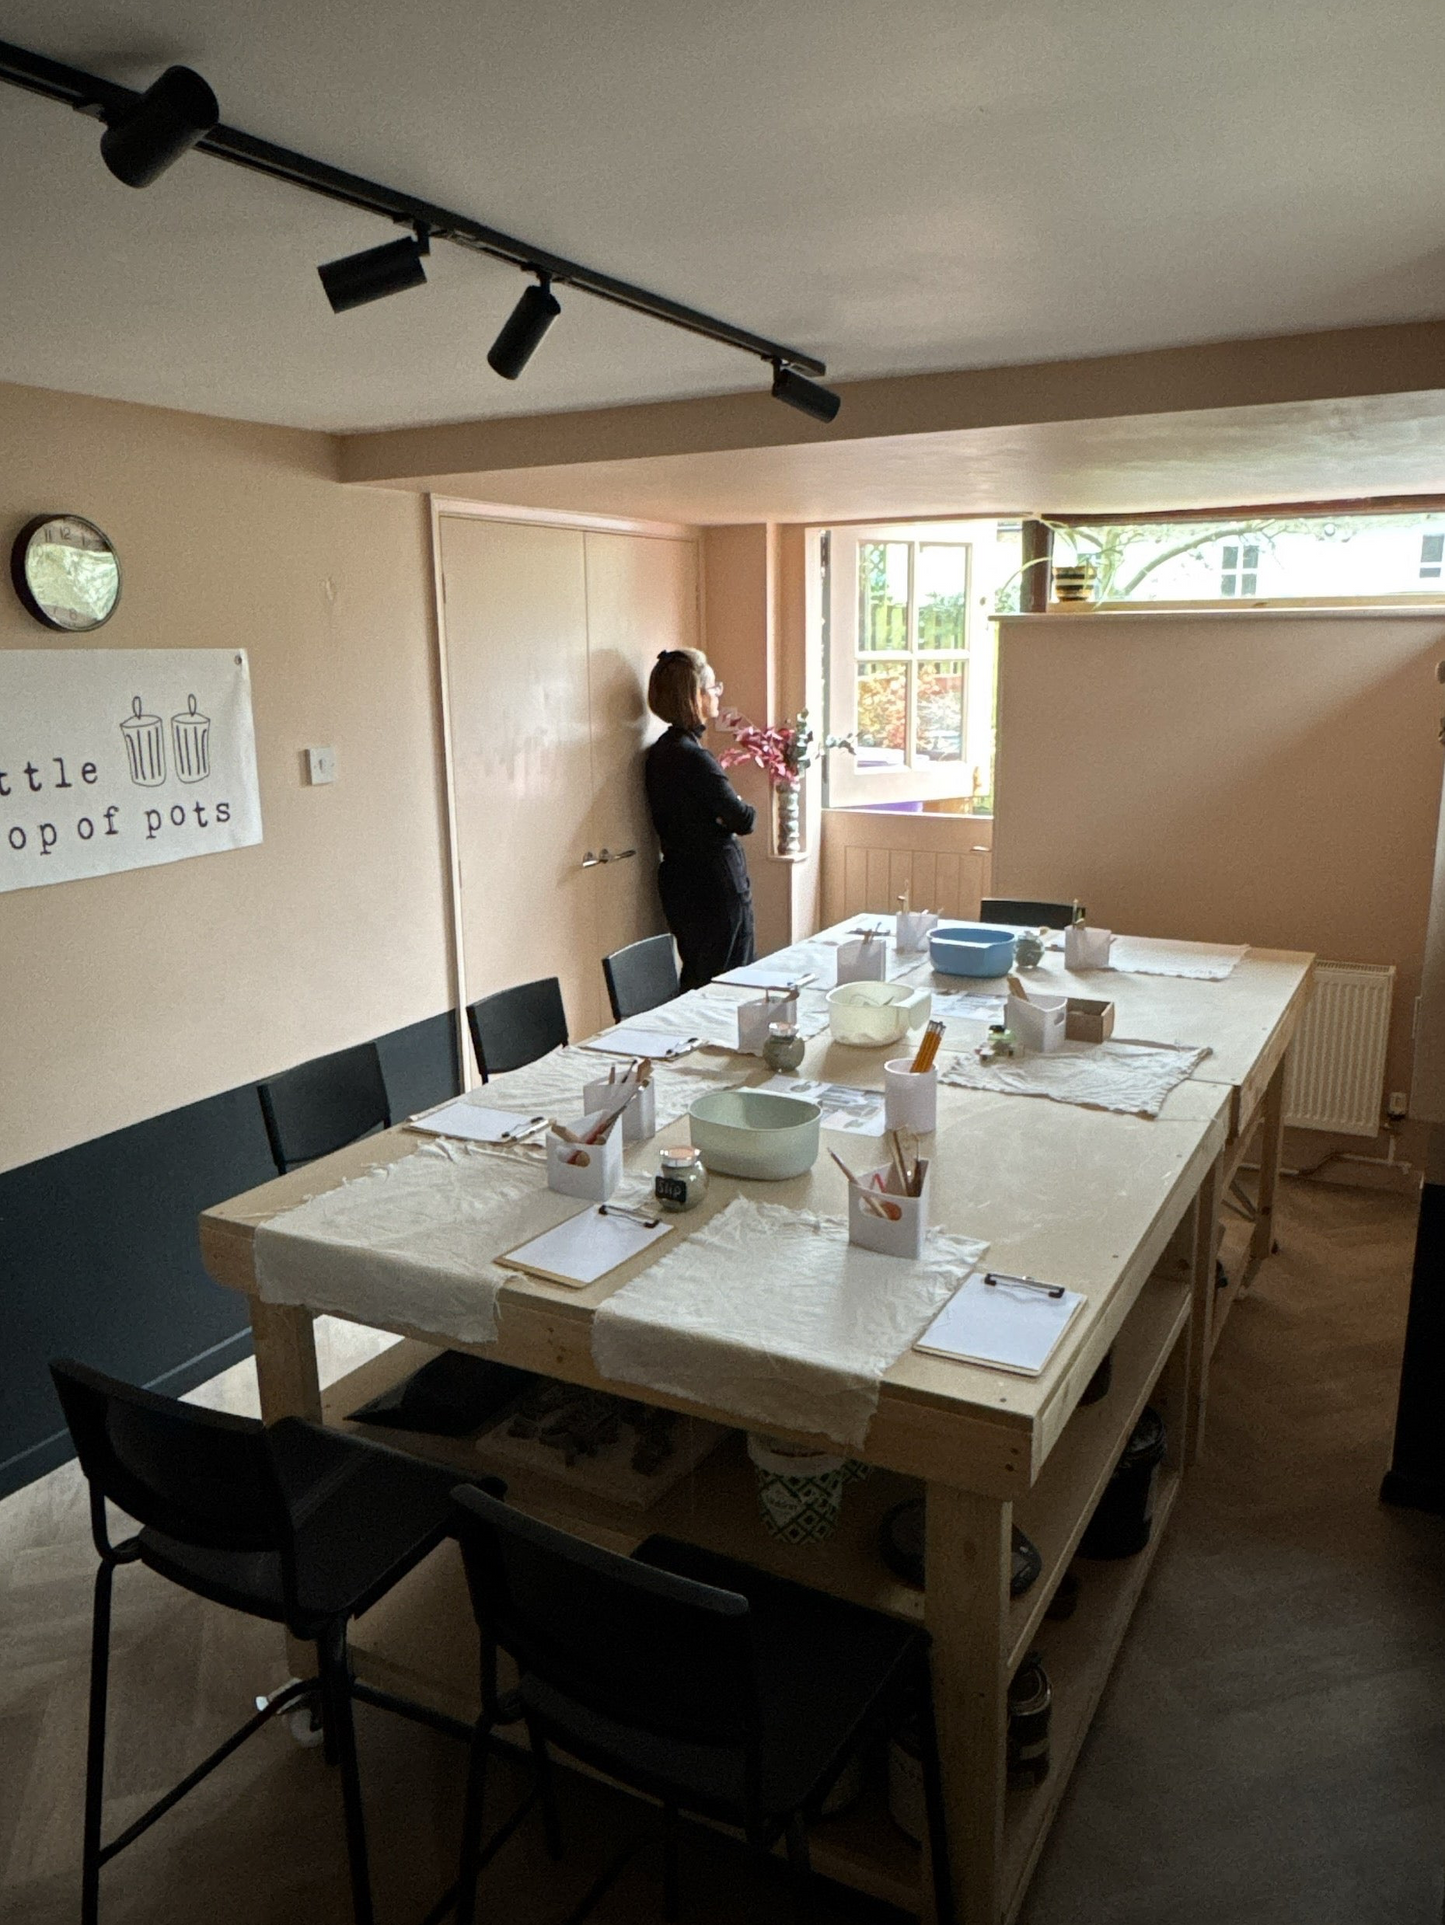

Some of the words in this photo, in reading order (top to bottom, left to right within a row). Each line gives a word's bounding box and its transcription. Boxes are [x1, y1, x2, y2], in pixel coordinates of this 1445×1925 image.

[60, 526, 71, 540] 12
[0, 757, 98, 797] ttle
[8, 823, 57, 856] op
[77, 805, 119, 840] of
[145, 801, 231, 840] pots
